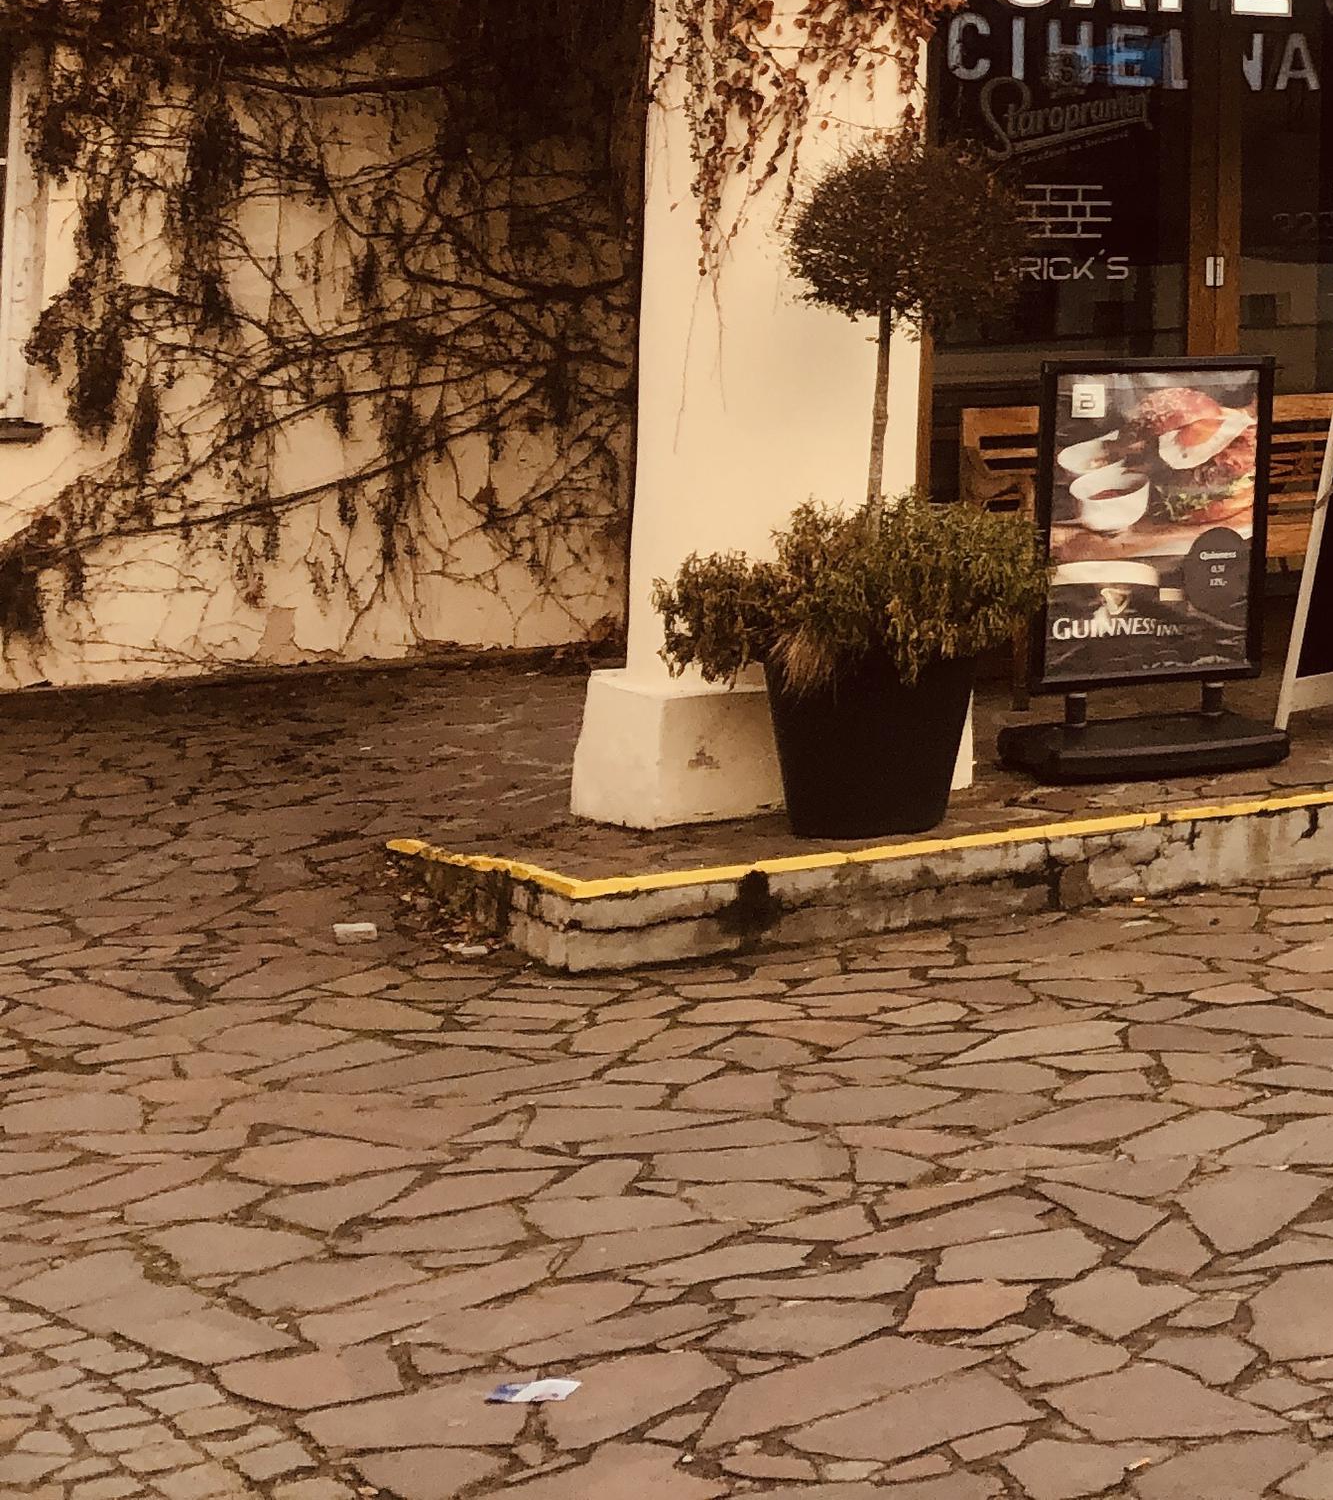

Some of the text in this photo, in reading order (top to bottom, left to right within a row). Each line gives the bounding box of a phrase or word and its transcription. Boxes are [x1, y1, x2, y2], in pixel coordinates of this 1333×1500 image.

[980, 77, 1152, 160] Staropramen
[995, 249, 1130, 281] RICK'S
[1052, 617, 1157, 640] GUINNESS
